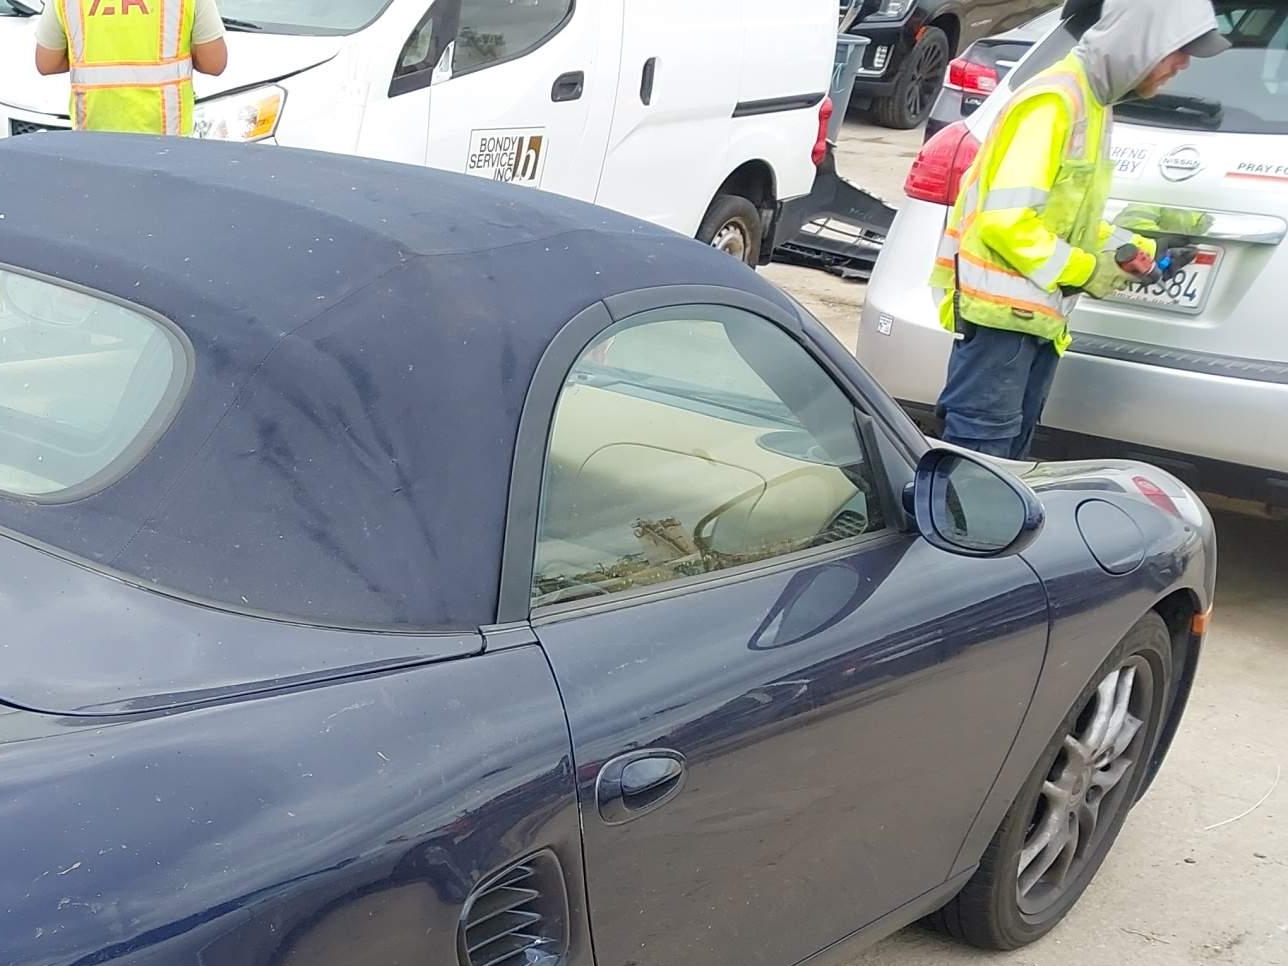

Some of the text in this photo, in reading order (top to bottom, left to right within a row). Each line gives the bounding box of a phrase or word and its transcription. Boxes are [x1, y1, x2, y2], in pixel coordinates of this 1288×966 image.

[479, 136, 517, 153] BONDY
[469, 152, 515, 169] SERVICE
[1162, 157, 1202, 169] NISSAN
[1237, 161, 1274, 174] PRAY
